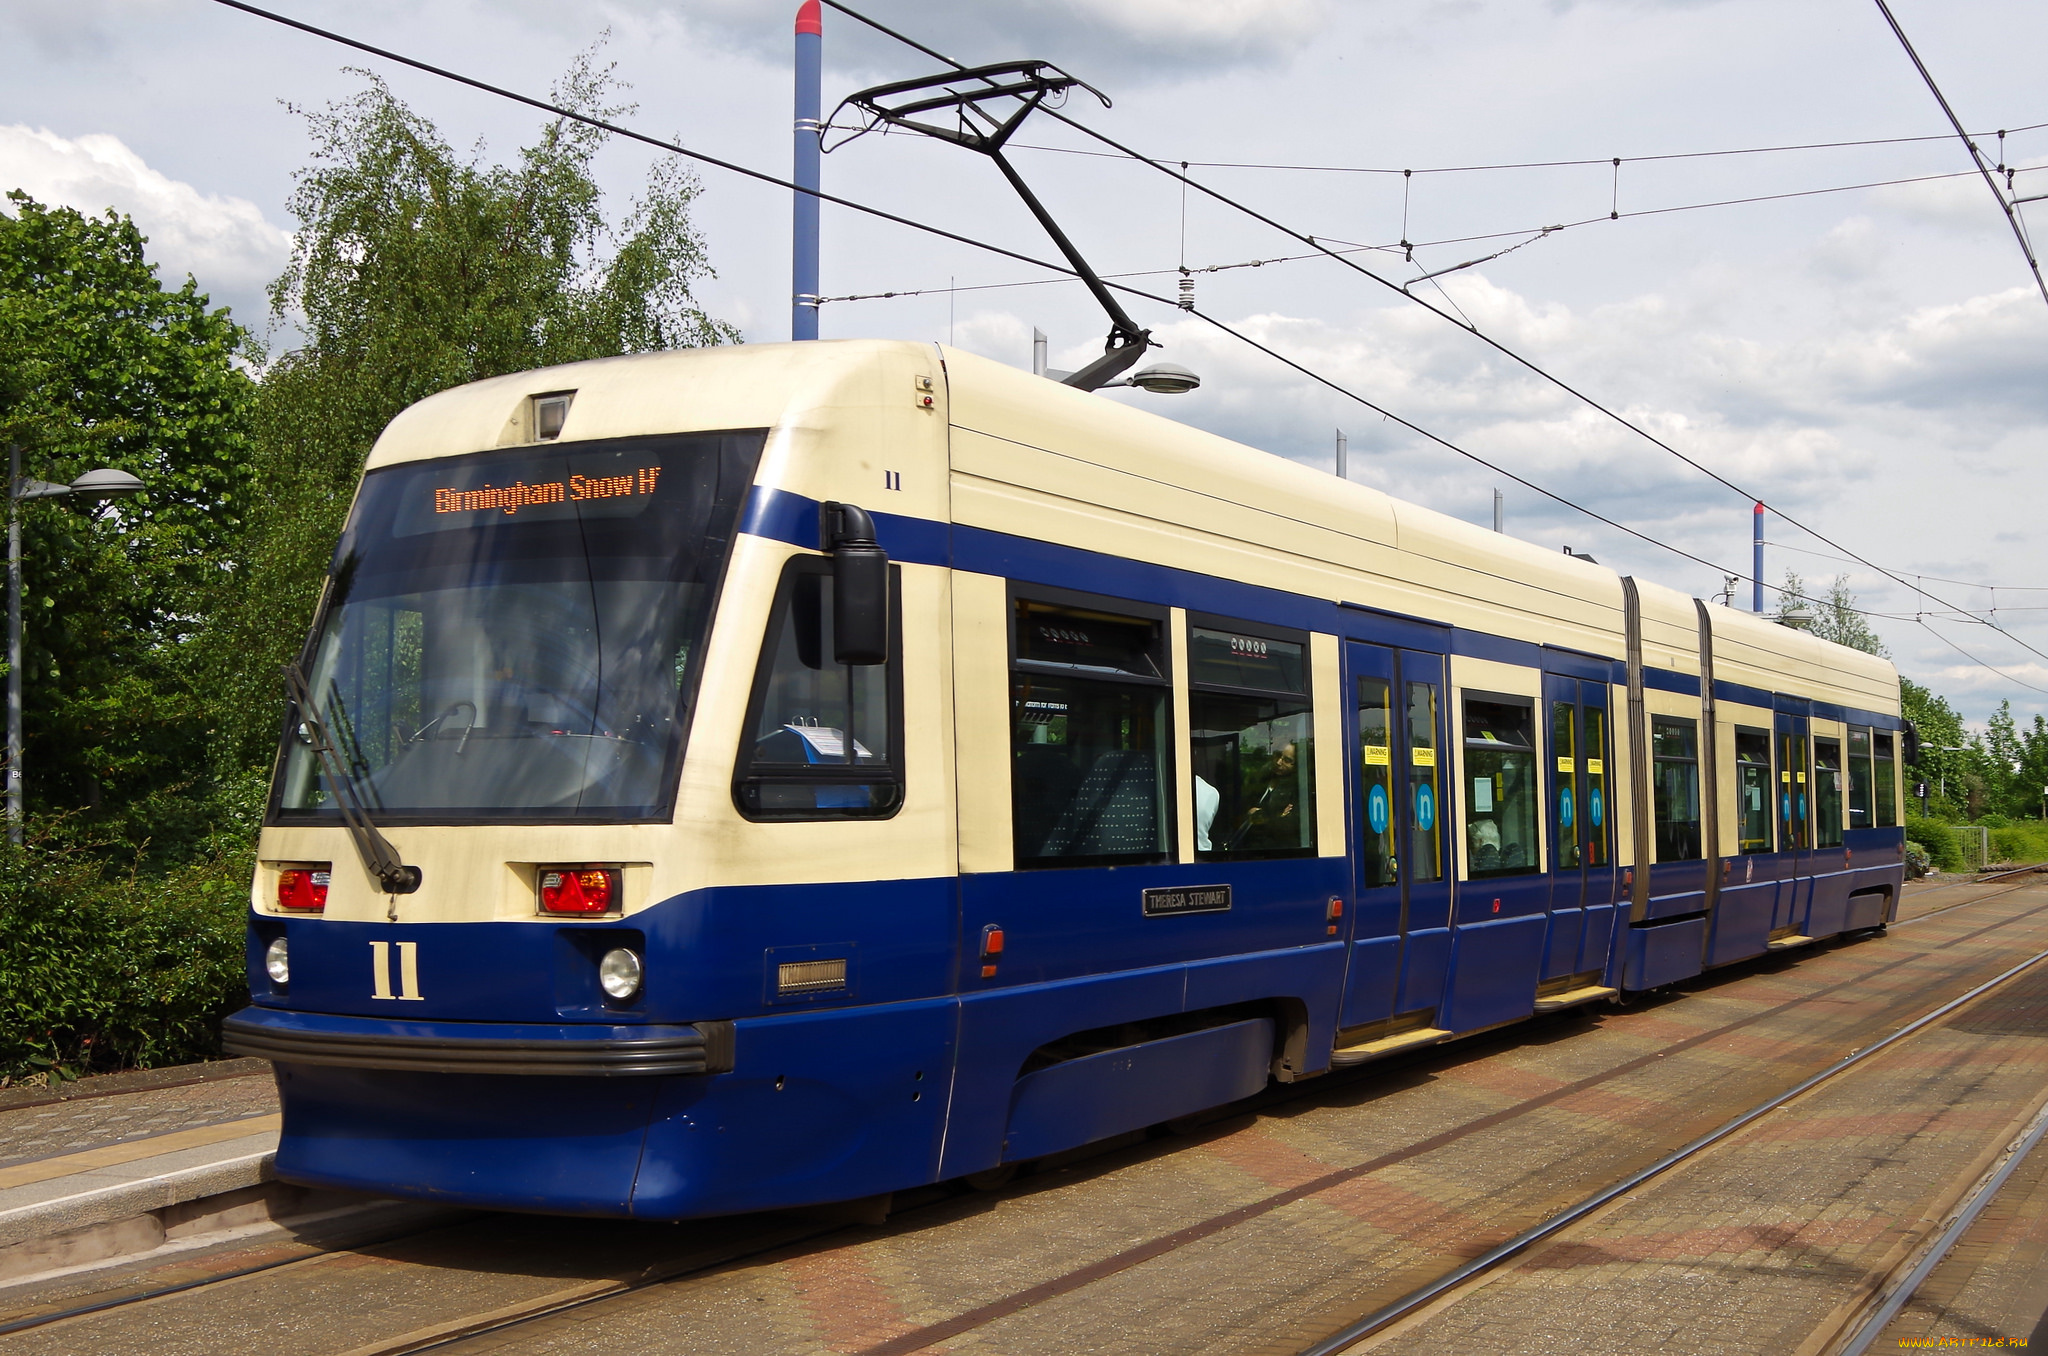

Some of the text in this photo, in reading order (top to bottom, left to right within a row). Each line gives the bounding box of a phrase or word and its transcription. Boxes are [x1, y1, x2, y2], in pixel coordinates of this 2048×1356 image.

[435, 466, 662, 515] Birmingham Snow H
[884, 469, 902, 492] 11
[1373, 795, 1385, 822] n
[1420, 794, 1431, 820] n
[1563, 797, 1571, 818] n
[1593, 797, 1601, 818] n
[1149, 890, 1226, 909] THERESA STEWART
[368, 941, 425, 1001] 11
